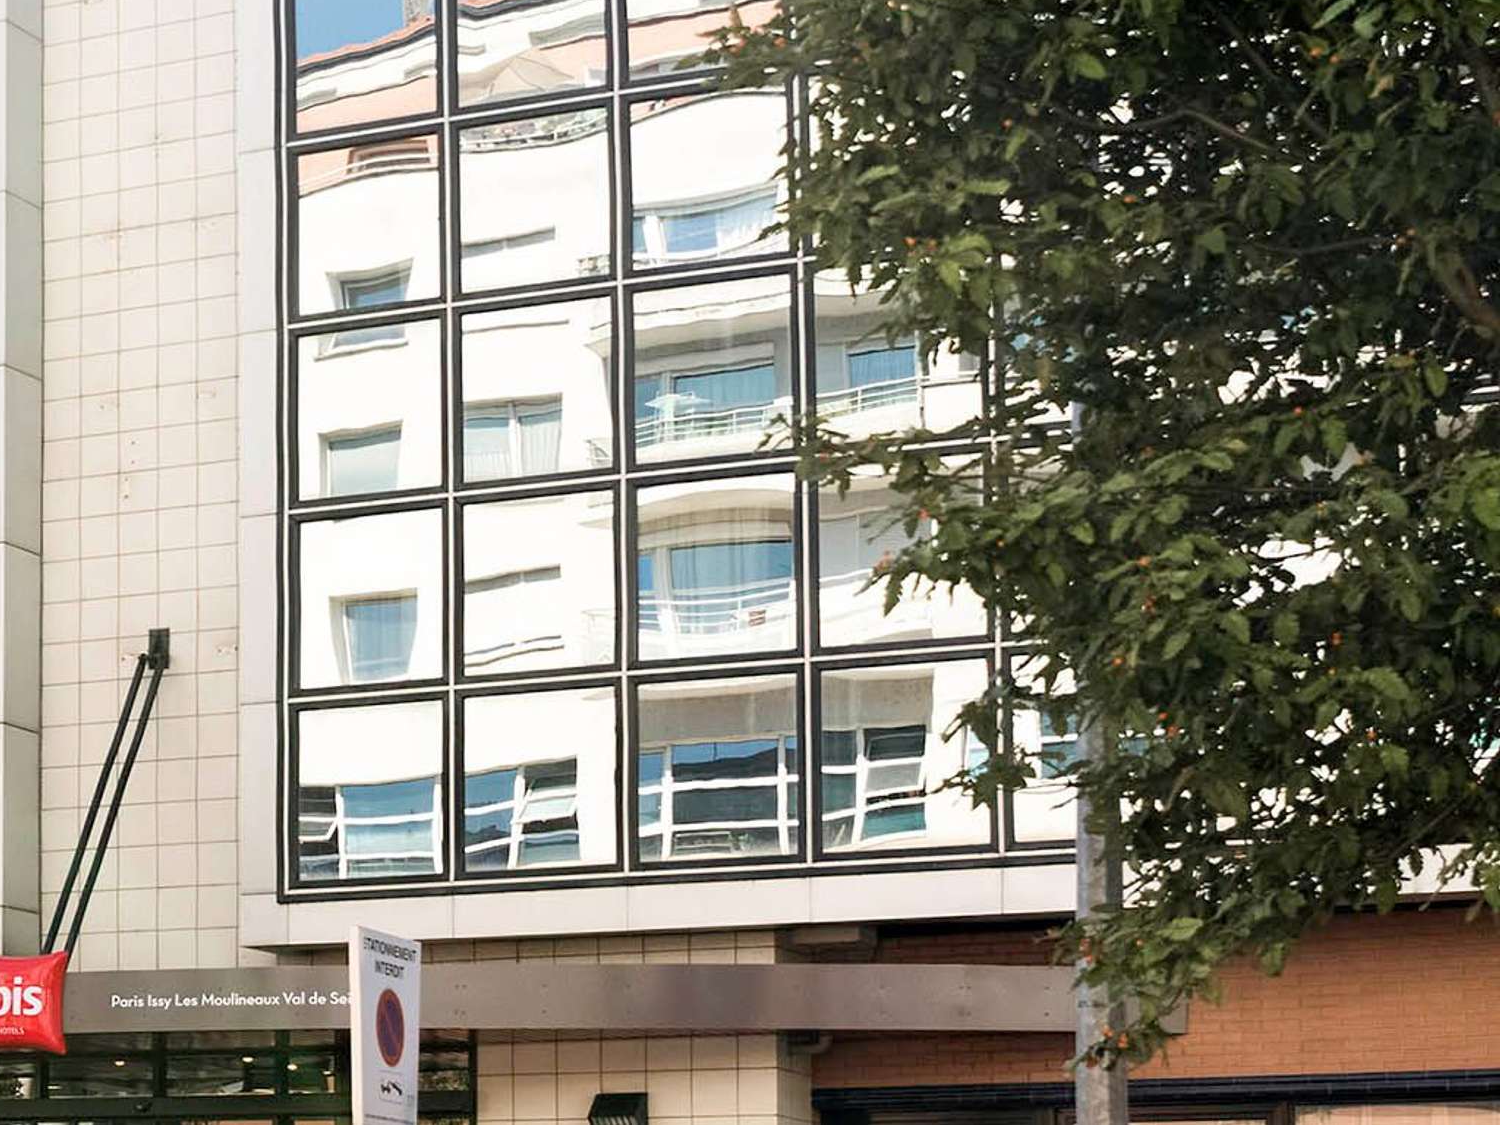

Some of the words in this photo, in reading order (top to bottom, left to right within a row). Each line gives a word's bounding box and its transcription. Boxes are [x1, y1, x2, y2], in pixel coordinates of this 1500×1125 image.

[110, 994, 145, 1008] Paris
[146, 993, 172, 1010] Issy
[174, 992, 198, 1007] Les
[200, 992, 280, 1007] Moulineaux
[282, 990, 306, 1005] Val
[308, 990, 327, 1005] de
